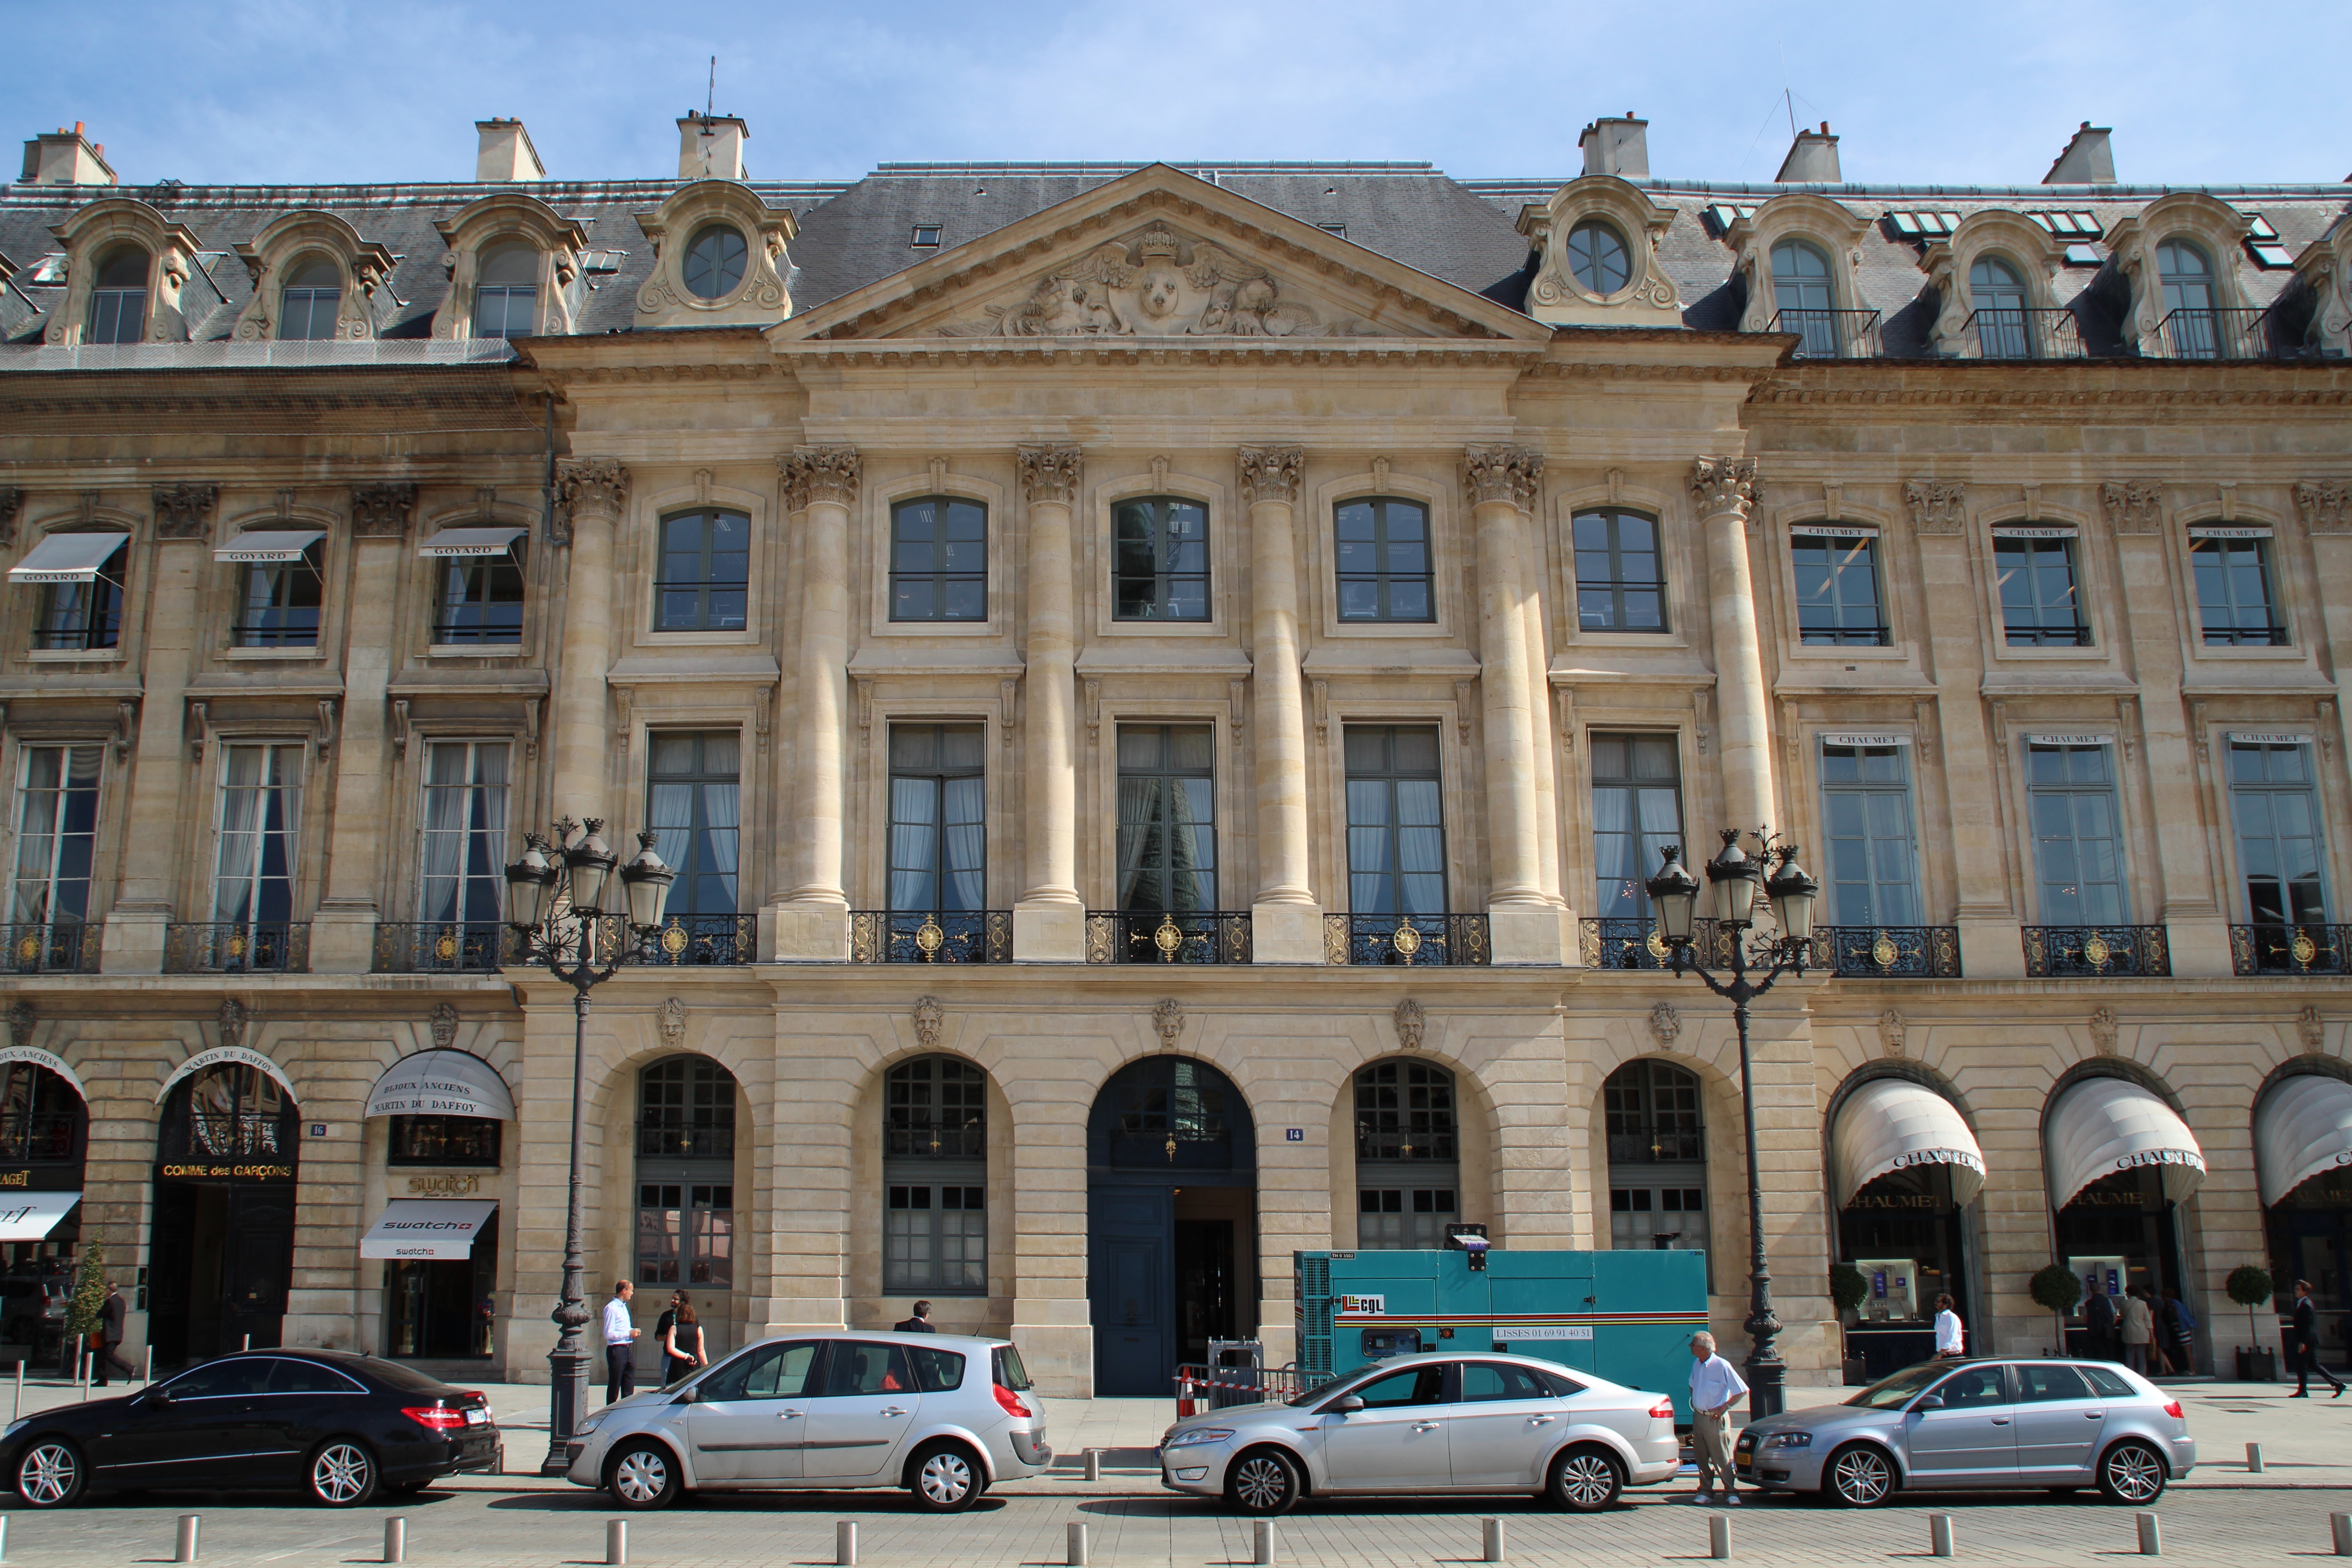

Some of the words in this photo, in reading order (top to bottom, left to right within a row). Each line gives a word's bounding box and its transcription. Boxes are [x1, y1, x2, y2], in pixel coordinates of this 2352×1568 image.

[1809, 528, 1862, 536] CHAUMET
[1839, 736, 1897, 744] CHAUMET
[20, 1050, 59, 1068] ANCIENS
[241, 1052, 274, 1072] DAFFOY
[384, 1082, 418, 1094] BIJOUX
[421, 1082, 471, 1094] ANCIENS
[374, 1100, 407, 1112] MARTIN
[412, 1099, 426, 1108] DU
[432, 1100, 478, 1112] DAFFOY
[314, 1126, 323, 1134] 16
[1289, 1130, 1300, 1139] 14
[163, 1165, 208, 1176] COMME
[211, 1166, 230, 1176] des
[234, 1165, 292, 1181] GARÇONS
[408, 1174, 479, 1192] swatch
[2068, 1192, 2150, 1205] HAUMET
[383, 1221, 458, 1230] swatch
[1496, 1329, 1530, 1337] LISSES
[1532, 1329, 1541, 1337] 01
[1544, 1329, 1554, 1337] 69
[1568, 1328, 1578, 1337] 40
[1581, 1328, 1590, 1337] 51
